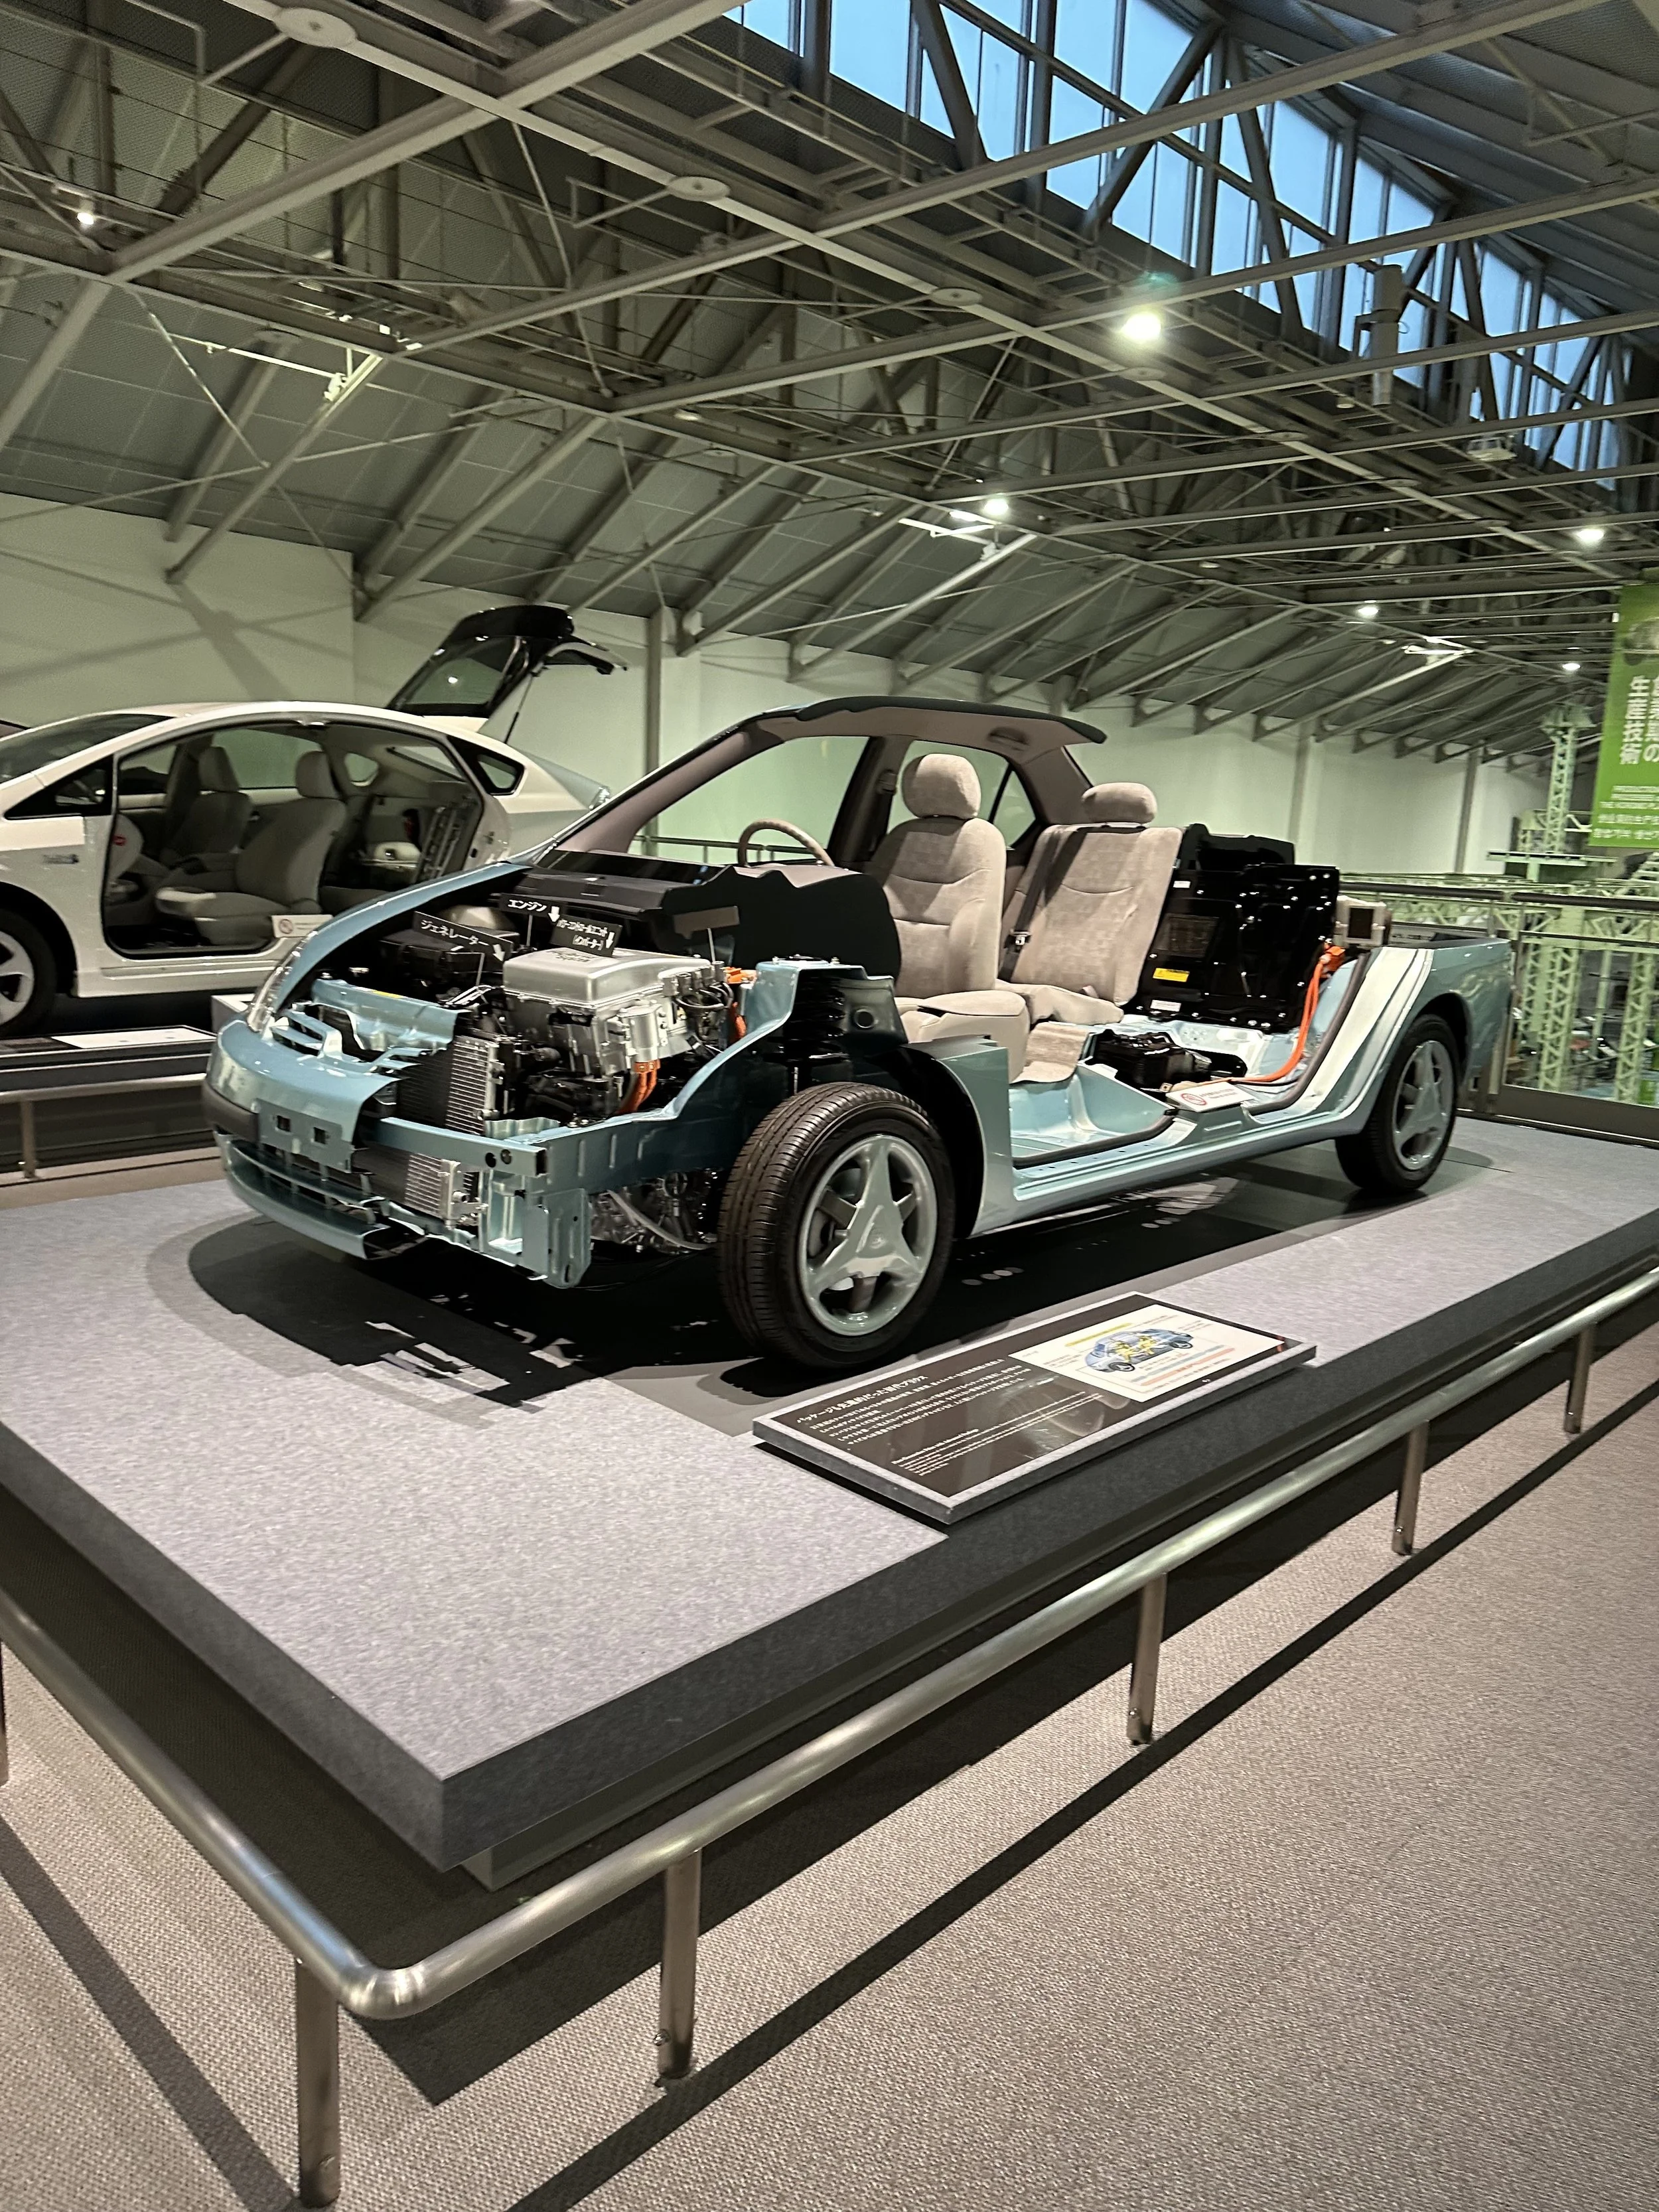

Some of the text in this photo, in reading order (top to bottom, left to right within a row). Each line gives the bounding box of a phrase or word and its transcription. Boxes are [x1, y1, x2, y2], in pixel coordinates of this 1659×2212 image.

[1620, 675, 1650, 765] 生産技術
[508, 899, 547, 912] エンジン
[421, 919, 490, 946] ジェネレーター
[796, 1375, 928, 1424] パッケージも先進的だった初代プリウス
